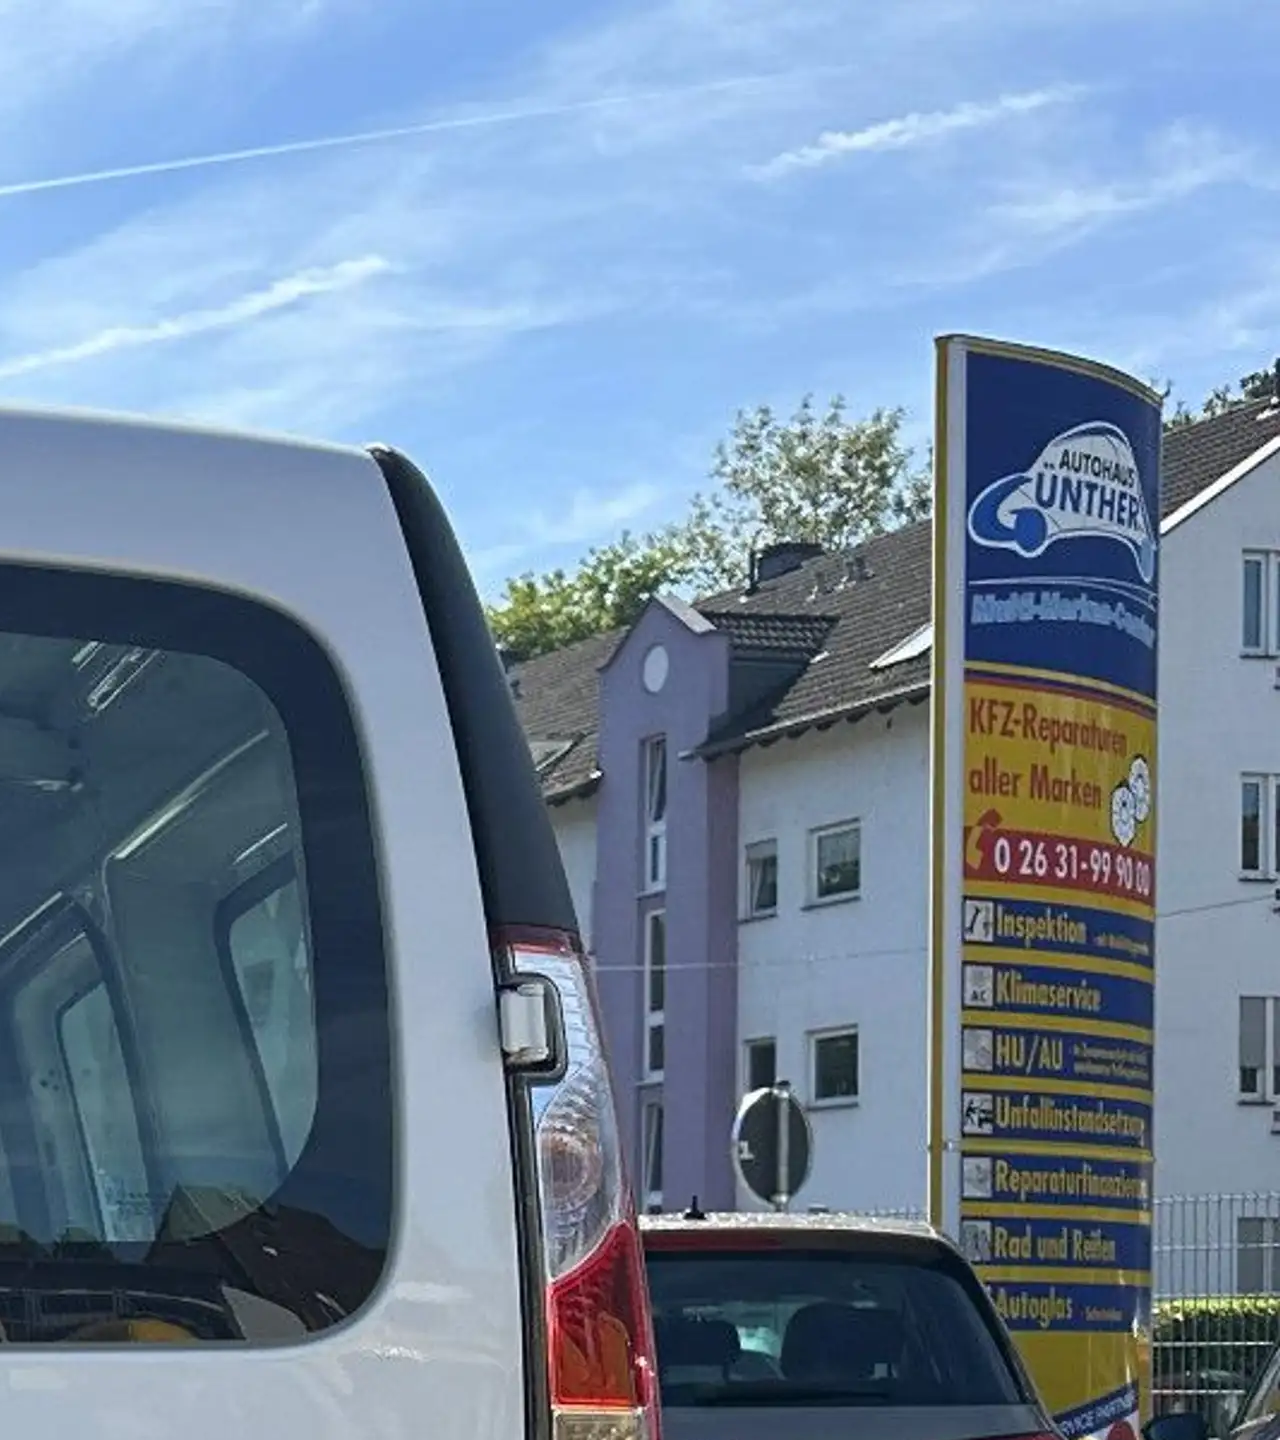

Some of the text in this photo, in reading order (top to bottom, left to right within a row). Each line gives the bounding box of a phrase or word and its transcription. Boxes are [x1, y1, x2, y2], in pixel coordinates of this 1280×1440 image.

[1058, 449, 1135, 486] AUTOHAUS
[969, 697, 1128, 758] KFZ-Reparaturen
[969, 755, 1102, 808] aller Marken
[996, 904, 1087, 949] Inspektion
[996, 969, 1102, 1011] Klimaservice
[994, 1223, 1116, 1261] Rad und Reifen
[996, 1285, 1073, 1327] Autoglas
